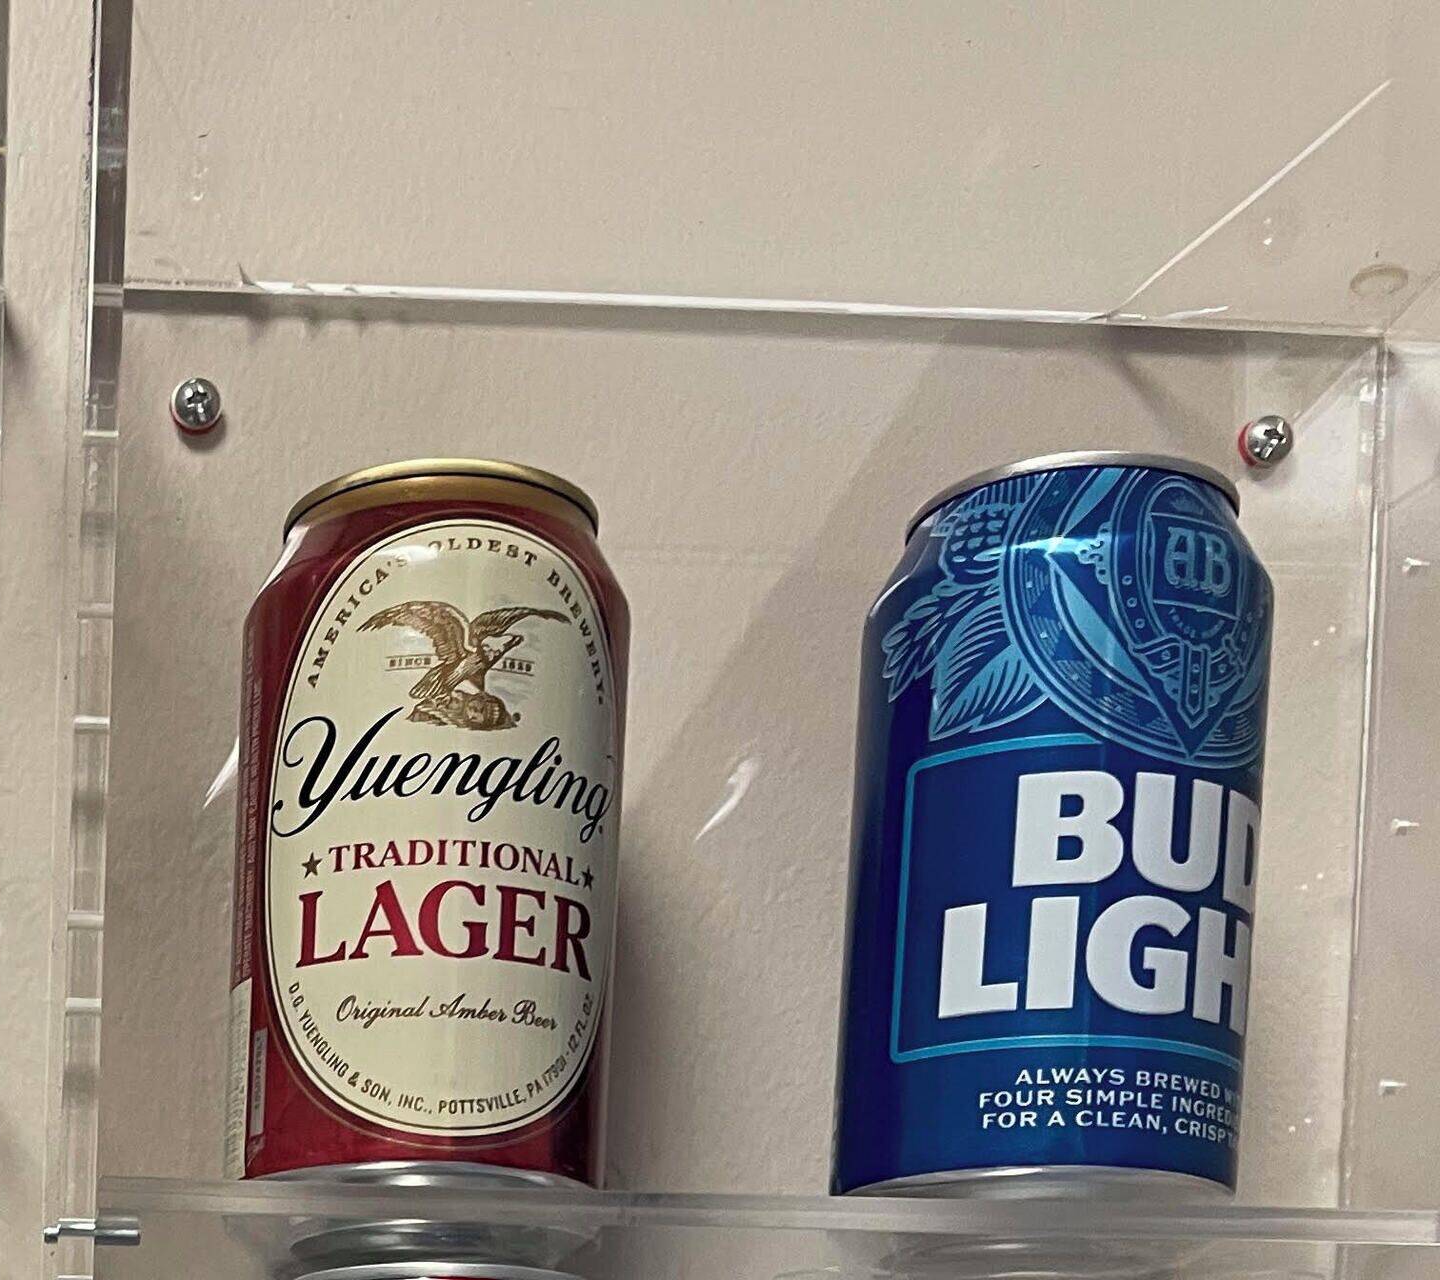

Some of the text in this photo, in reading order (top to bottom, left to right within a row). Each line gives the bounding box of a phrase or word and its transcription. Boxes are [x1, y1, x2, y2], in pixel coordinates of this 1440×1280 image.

[1164, 526, 1232, 598] AB
[306, 537, 604, 699] AMERICA'S OLDEST BREWERY
[271, 706, 611, 843] Yuengling
[328, 839, 582, 886] TRADITIONAL
[1012, 770, 1260, 905] BUD
[295, 879, 592, 982] LAGER
[938, 895, 1254, 1036] LIGH
[336, 992, 559, 1031] Original Amber Beer
[298, 1009, 348, 1077] YUENGLING
[346, 1072, 360, 1088] &
[526, 1081, 544, 1102] PA
[1015, 1068, 1126, 1087] ALWAYS
[1136, 1070, 1221, 1099] BREWED
[979, 1089, 1164, 1110] FOUR SIMPLE
[982, 1112, 1037, 1130] FOR
[1047, 1111, 1065, 1127] A
[1076, 1110, 1168, 1135] CLEAN,
[1174, 1118, 1226, 1145] CRISP
